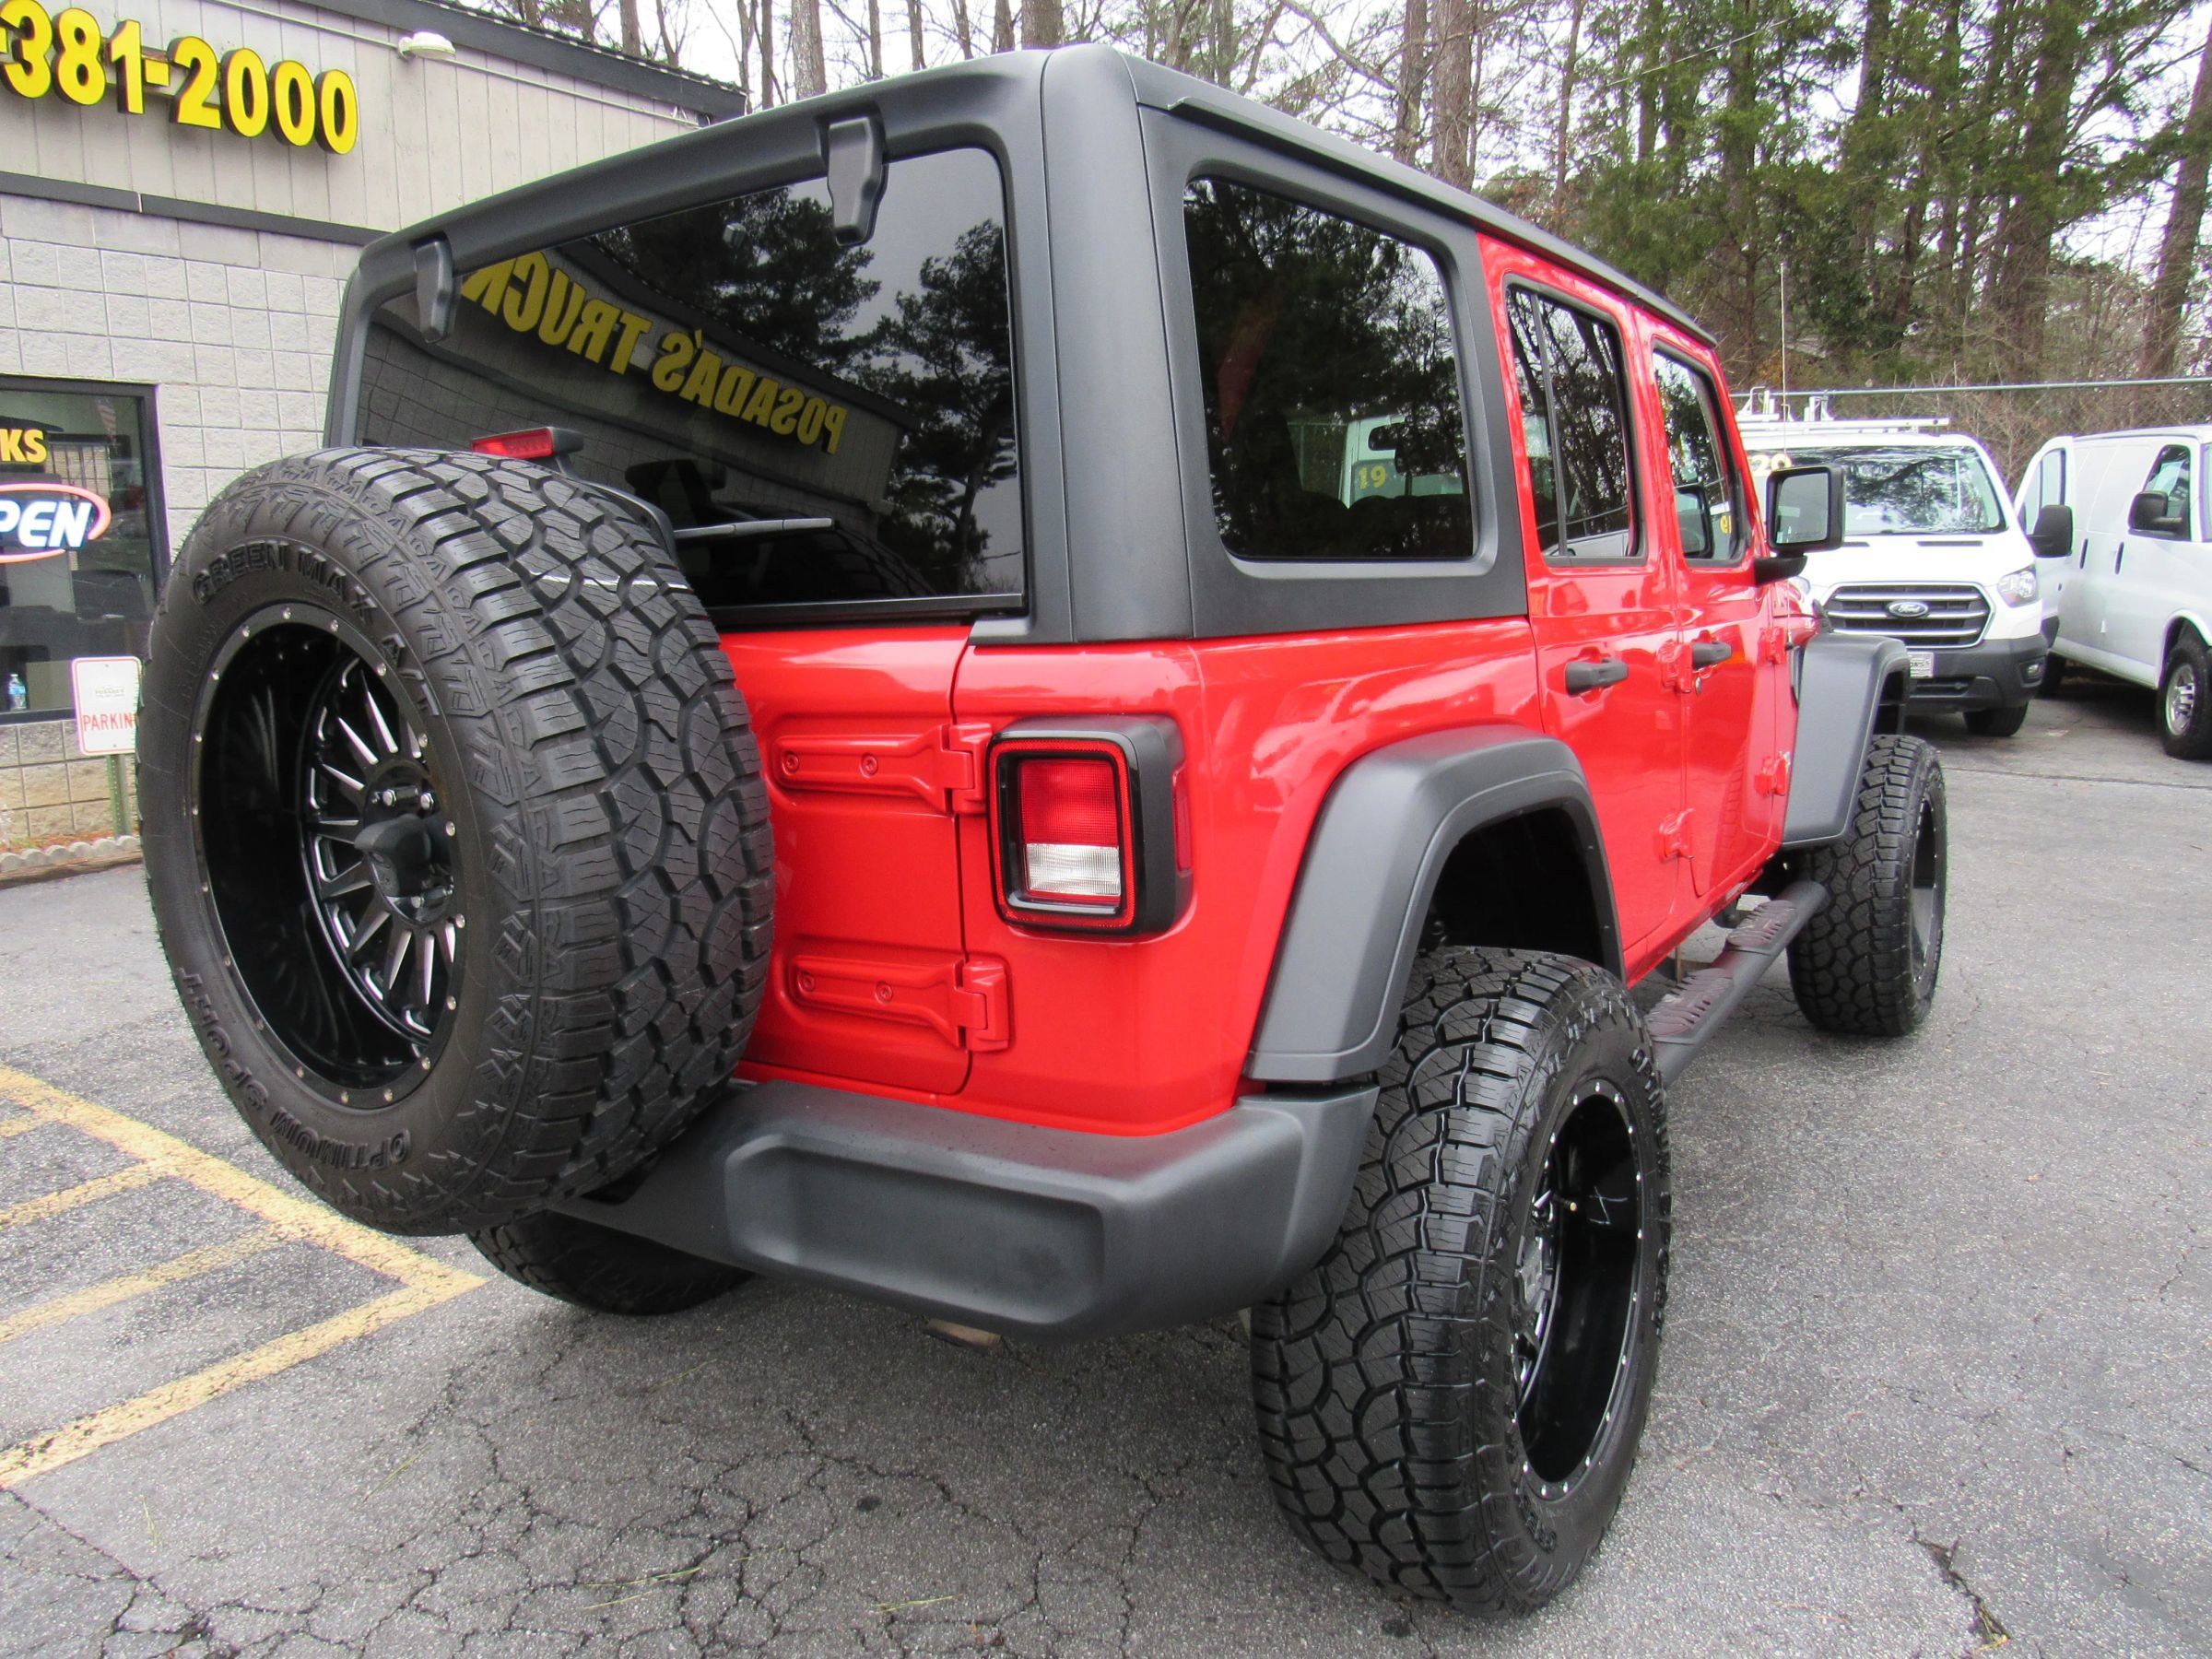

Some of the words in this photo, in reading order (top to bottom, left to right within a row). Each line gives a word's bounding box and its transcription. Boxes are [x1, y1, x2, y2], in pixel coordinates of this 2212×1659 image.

[1359, 465, 1387, 489] 19
[193, 539, 289, 605] GREEN
[297, 547, 377, 625] MAX
[82, 712, 136, 732] PARKIN
[269, 1108, 411, 1171] OPTIMUM
